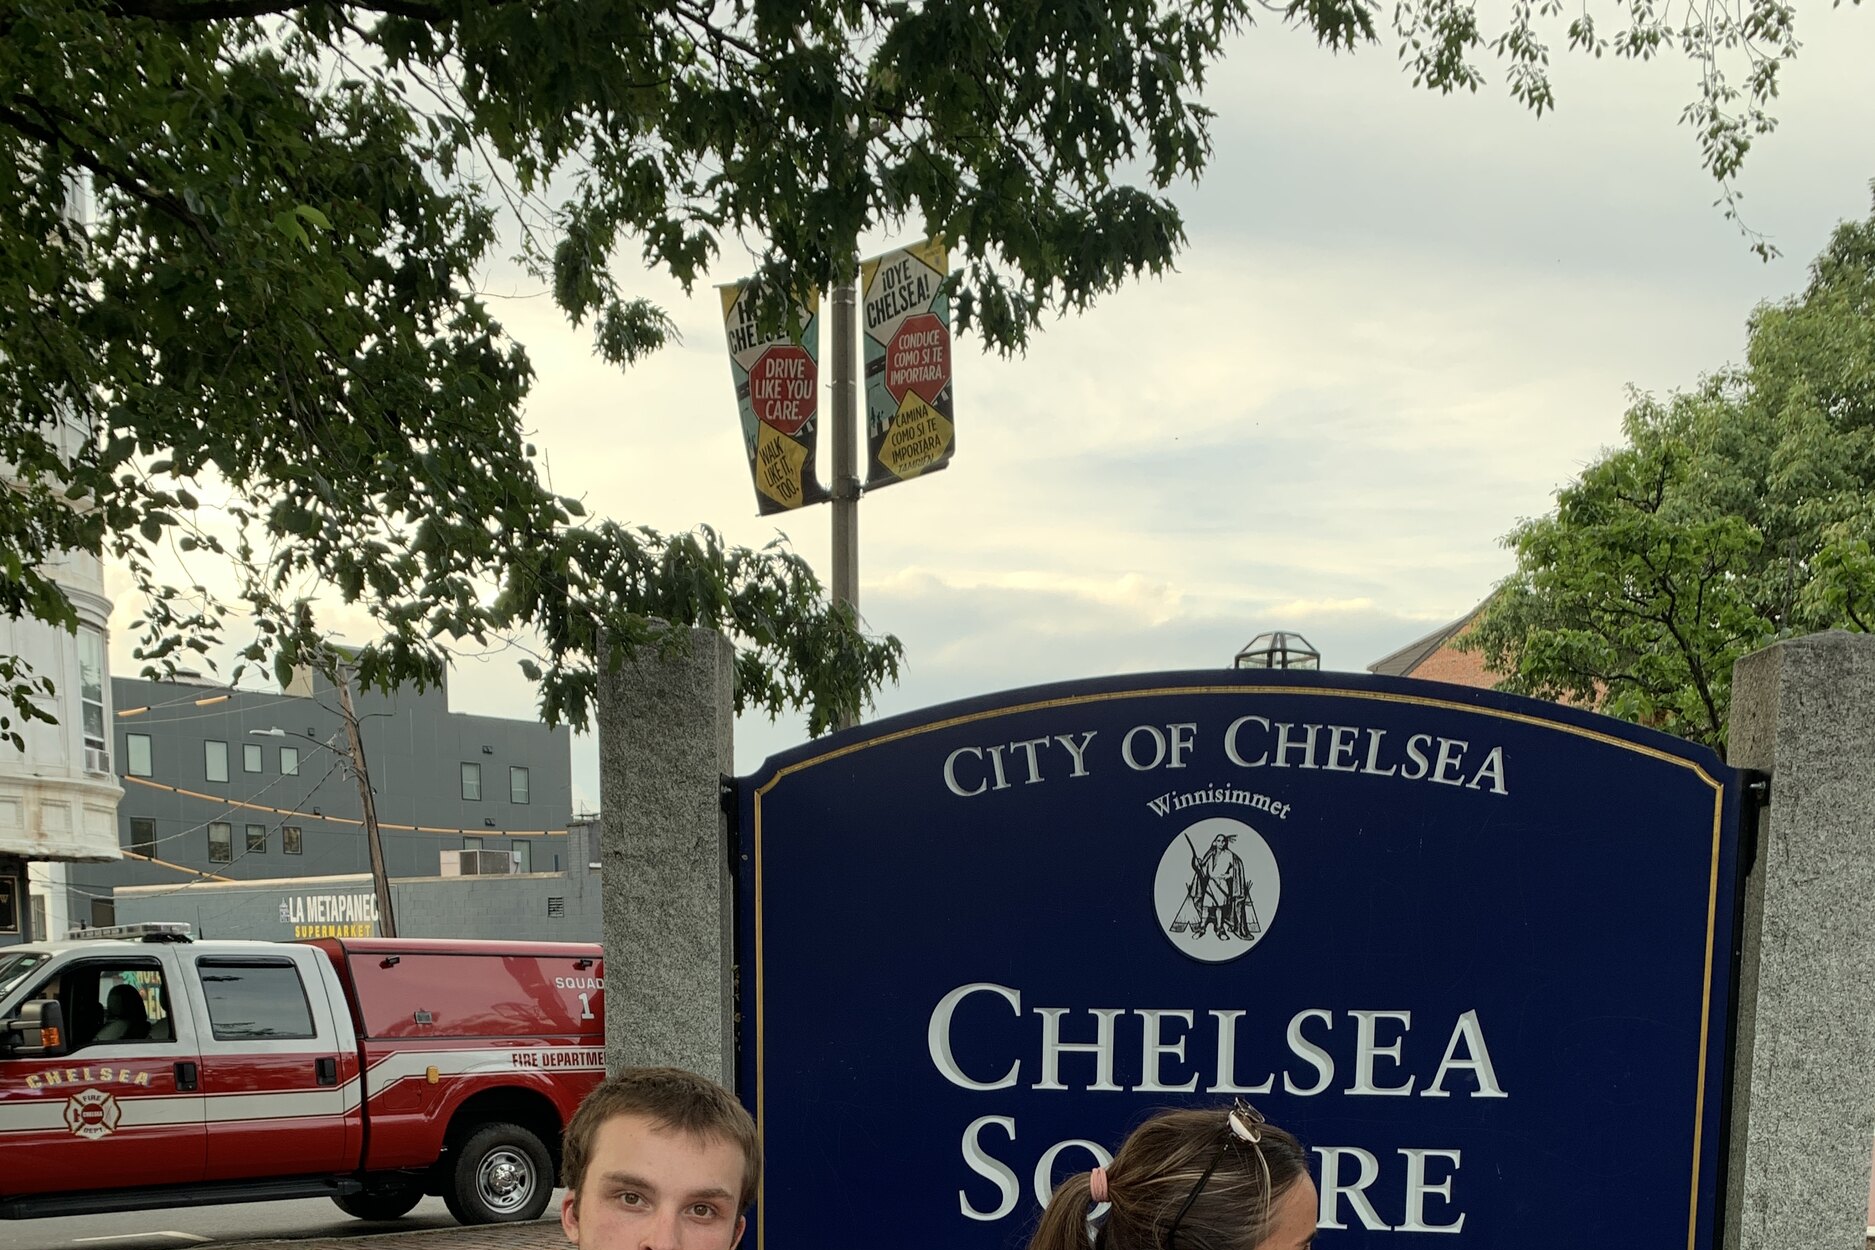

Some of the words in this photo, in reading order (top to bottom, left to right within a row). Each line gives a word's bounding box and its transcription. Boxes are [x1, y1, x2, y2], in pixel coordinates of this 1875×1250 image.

[881, 256, 911, 291] ¡OYE
[866, 274, 930, 329] CHELSEA!
[898, 329, 940, 349] CONDUCE
[893, 351, 919, 368] COMO
[921, 349, 931, 365] SI
[931, 346, 943, 364] TE
[765, 358, 805, 384] DRIVE
[890, 366, 946, 386] IMPORTARA.
[755, 379, 783, 399] LIKE
[786, 379, 812, 399] YOU
[765, 400, 803, 420] CARE.
[895, 404, 929, 428] CAMINA
[891, 427, 916, 447] COMO
[916, 422, 925, 437] SI
[926, 417, 937, 433] TE
[758, 436, 784, 467] WALK
[891, 433, 942, 465] IMPORTARA
[764, 461, 783, 488] LIKE
[776, 480, 800, 502] TOO.
[943, 730, 1098, 797] CITY
[1121, 722, 1198, 771] OF
[1223, 715, 1510, 796] CHELSEA
[1146, 782, 1292, 820] Winnisimmet
[289, 896, 304, 923] LA
[306, 893, 379, 922] METAPANEC
[295, 925, 371, 938] SUPERMARKET
[555, 977, 605, 989] SQUAD
[578, 993, 595, 1019] 1
[927, 982, 1510, 1098] CHELSEA
[511, 1053, 538, 1067] FIRE
[542, 1052, 606, 1067] DEPARTME
[25, 1067, 149, 1089] CHELSEA
[82, 1094, 102, 1102] FIRE
[959, 1115, 1466, 1234] SQRE
